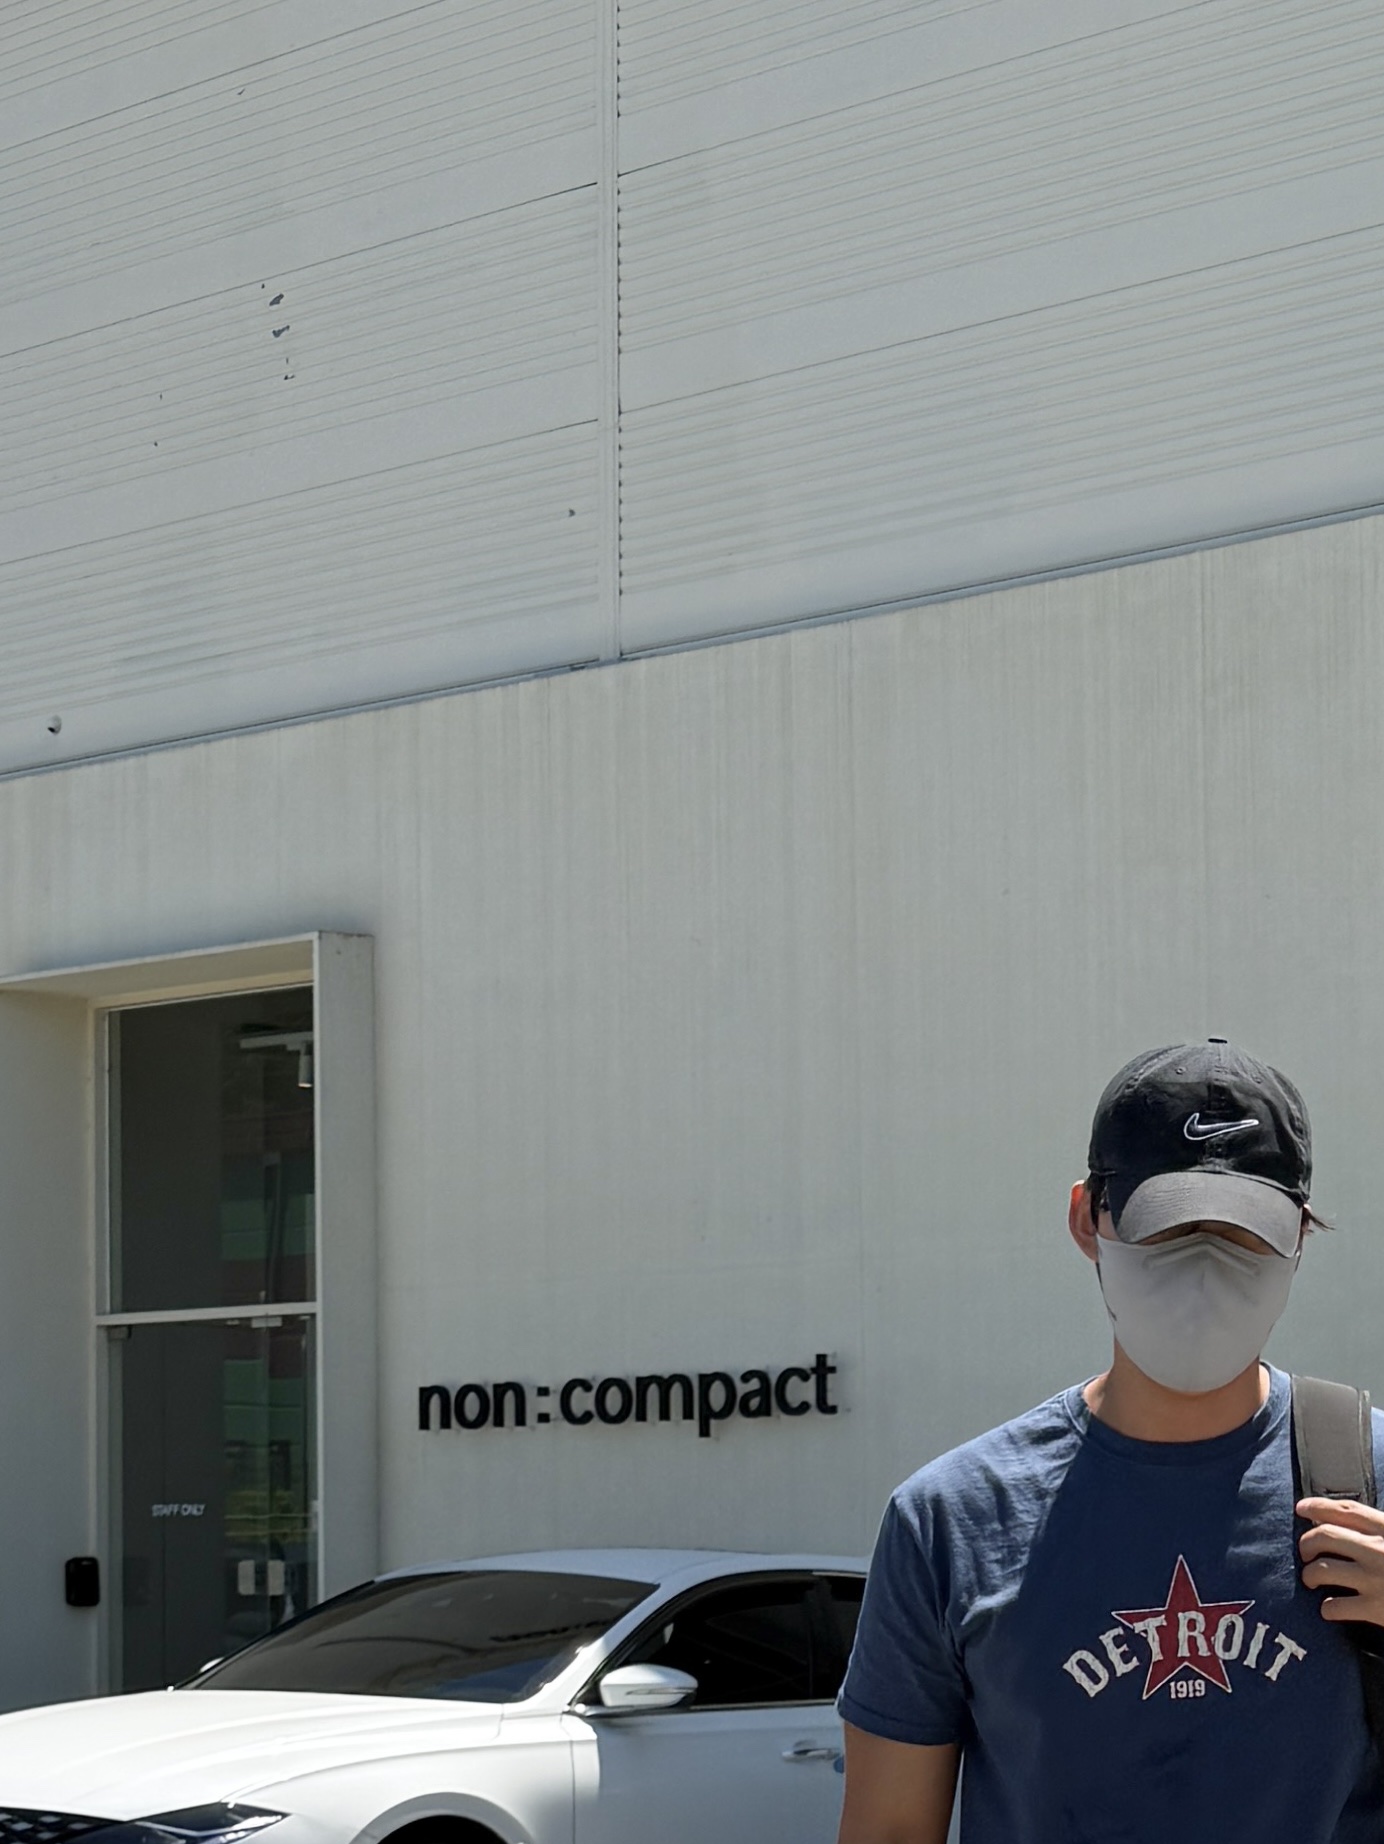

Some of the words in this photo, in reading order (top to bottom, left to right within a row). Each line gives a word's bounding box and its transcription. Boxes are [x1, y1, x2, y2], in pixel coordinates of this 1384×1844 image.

[418, 1353, 838, 1438] non:compact
[1062, 1610, 1307, 1698] DETROIT
[1169, 1679, 1206, 1699] 1919
